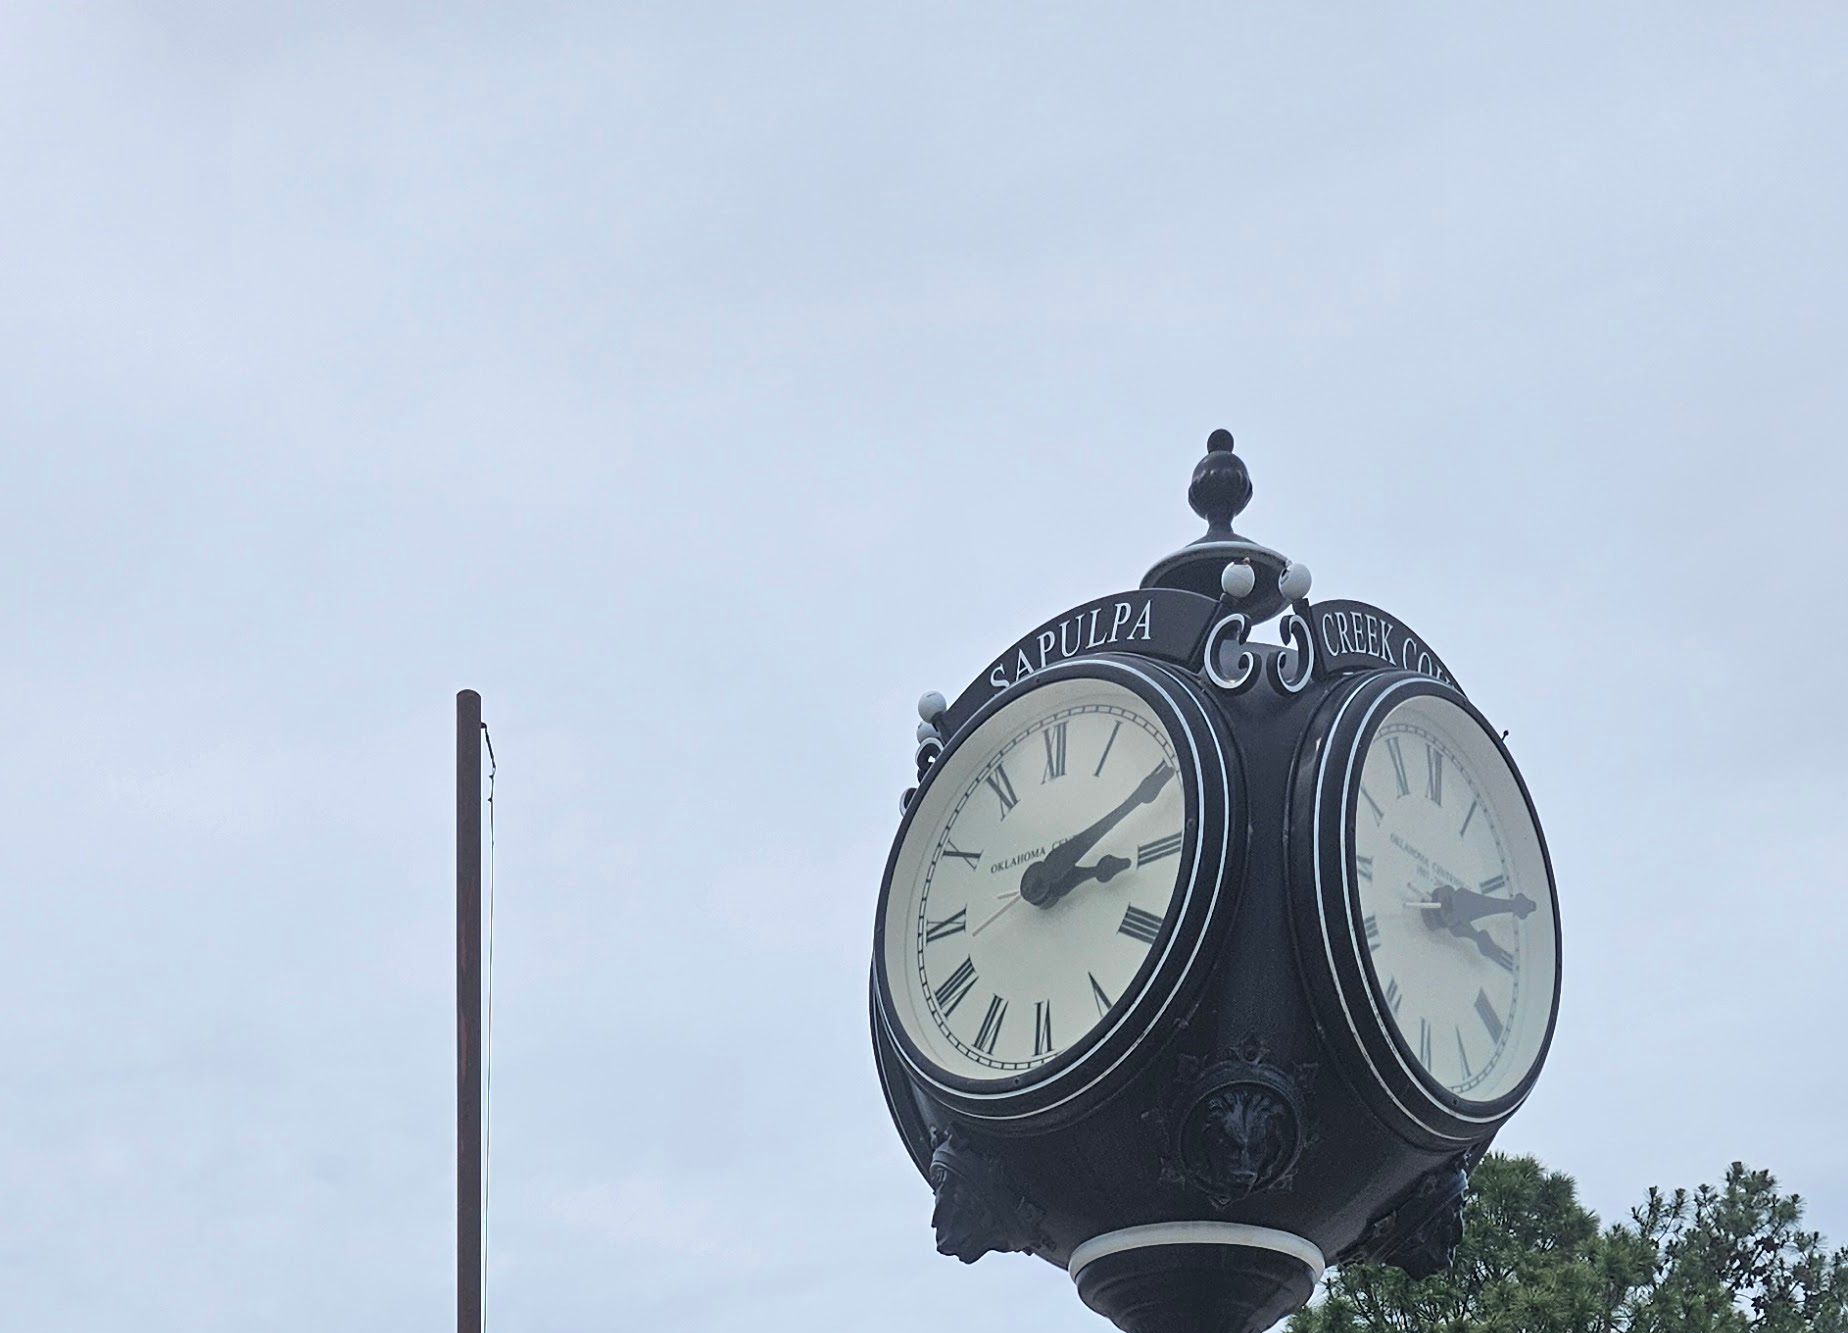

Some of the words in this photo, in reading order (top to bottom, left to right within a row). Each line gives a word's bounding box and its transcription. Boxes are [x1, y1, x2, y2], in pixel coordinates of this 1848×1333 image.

[989, 600, 1152, 696] SAPULPA
[1322, 611, 1397, 666] CREEK
[990, 847, 1047, 874] OKLAHOMA
